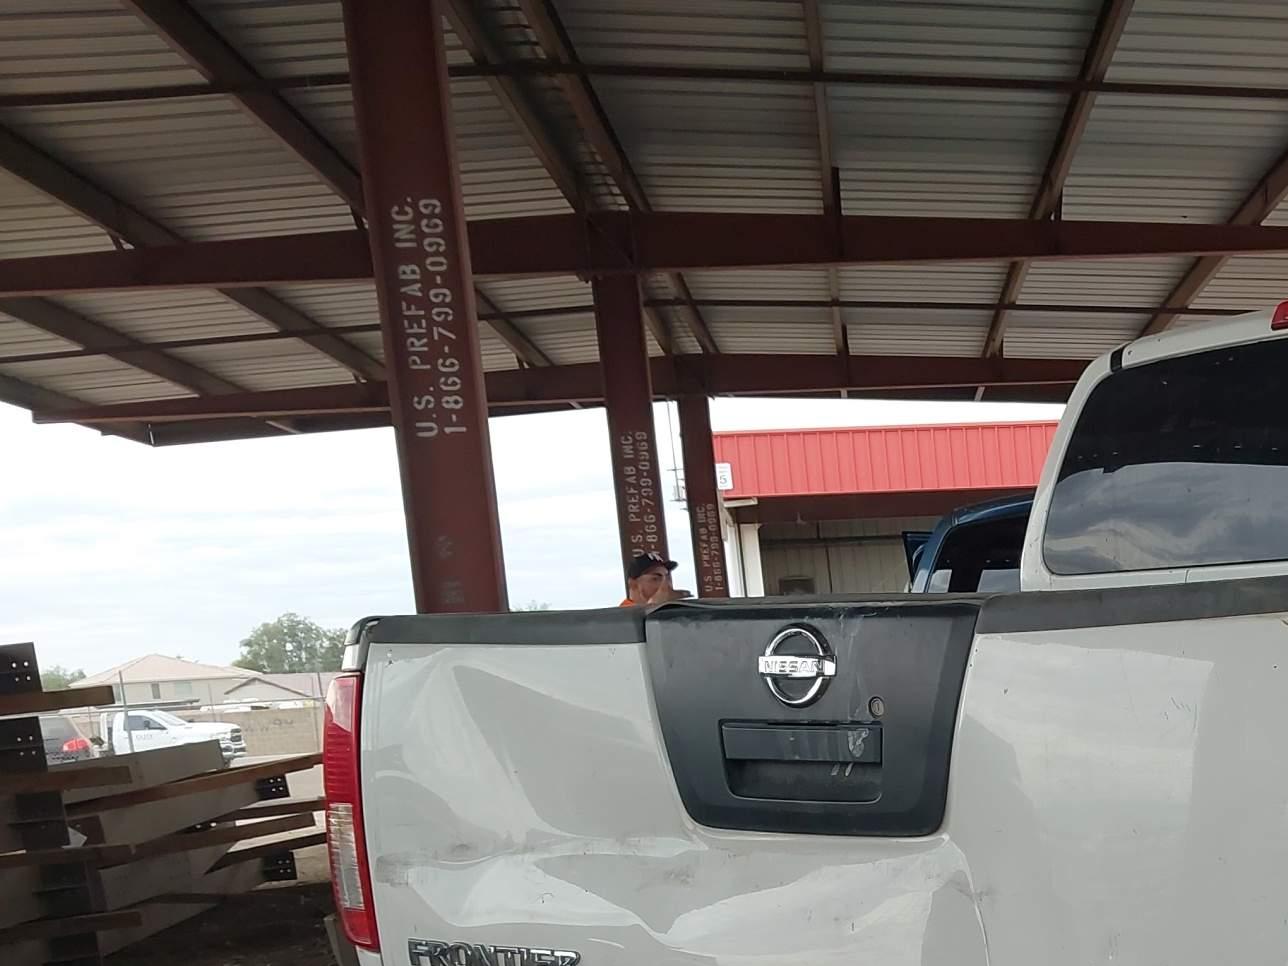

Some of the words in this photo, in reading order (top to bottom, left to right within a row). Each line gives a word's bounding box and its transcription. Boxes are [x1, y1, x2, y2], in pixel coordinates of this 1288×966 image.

[390, 196, 418, 249] INC.
[397, 263, 431, 371] PREFAB
[418, 198, 467, 435] 1-866-799-0969
[413, 385, 439, 439] U.S.
[623, 466, 641, 522] PREFAB
[763, 660, 826, 674] NISSAN
